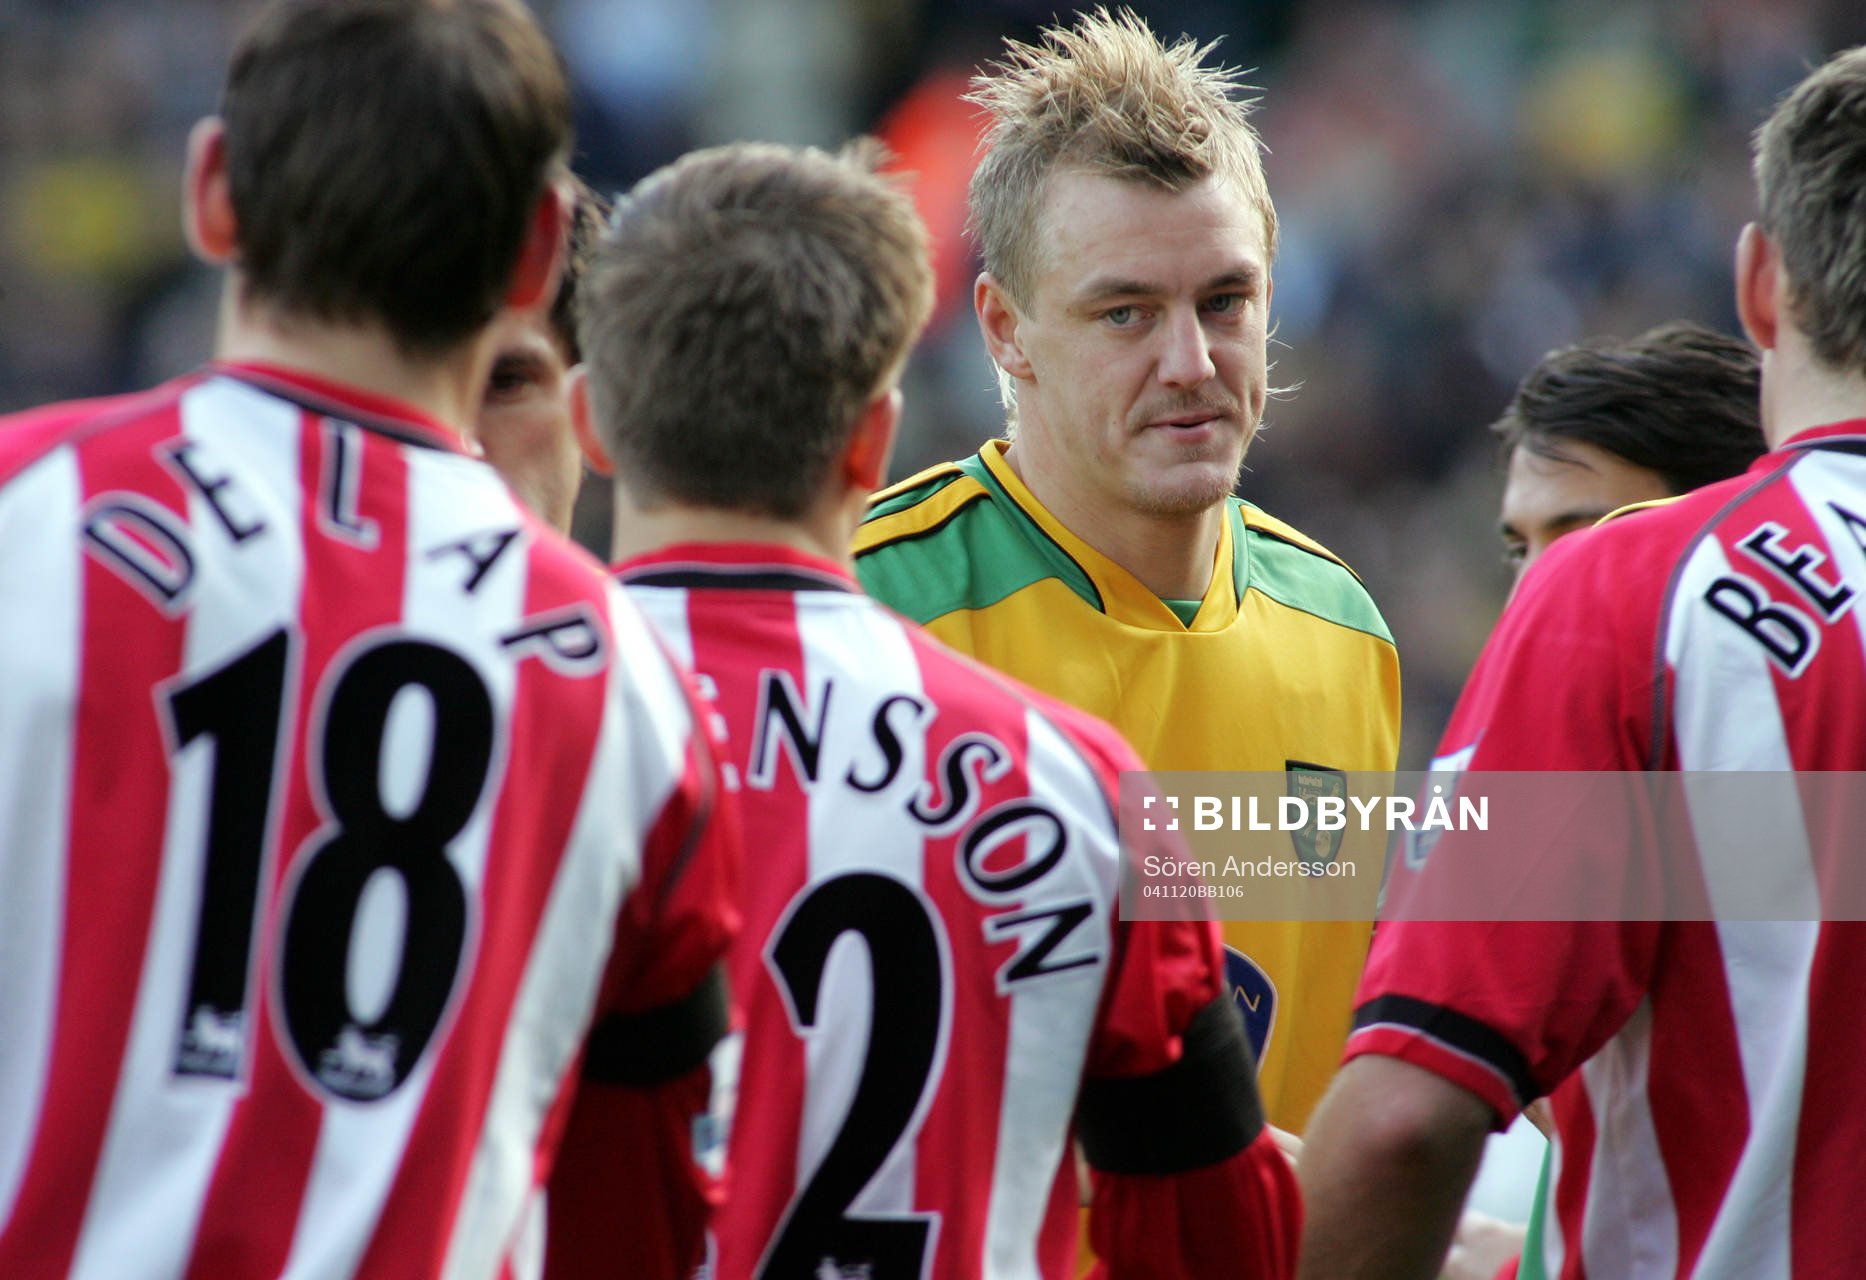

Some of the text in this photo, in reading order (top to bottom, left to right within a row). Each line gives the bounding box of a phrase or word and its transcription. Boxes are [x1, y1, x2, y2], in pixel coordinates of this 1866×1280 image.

[82, 418, 606, 677] DELAP
[156, 628, 500, 1103] 18
[697, 671, 1105, 995] NSSON
